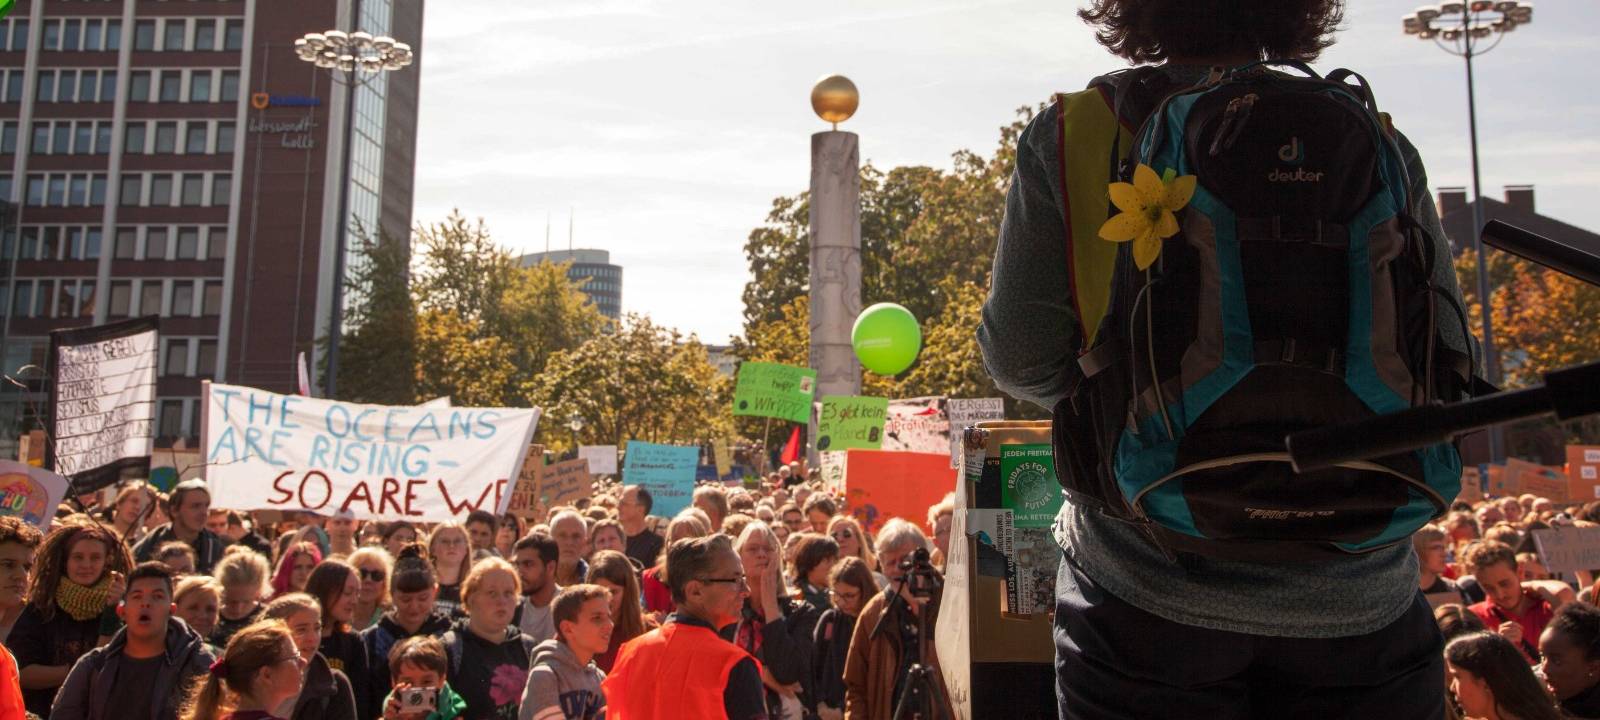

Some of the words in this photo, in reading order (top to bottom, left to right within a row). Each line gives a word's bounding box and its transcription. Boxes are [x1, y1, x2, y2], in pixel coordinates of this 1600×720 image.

[1268, 167, 1325, 182] deuter
[214, 389, 303, 428] THE
[325, 404, 501, 442] OCEANS
[951, 411, 965, 421] DAS
[868, 426, 880, 442] B
[209, 426, 292, 466] ARE
[309, 434, 430, 477] RISING
[1004, 450, 1026, 459] JEDEN
[1008, 461, 1031, 489] FRIDAYS
[1032, 461, 1048, 474] FOR
[267, 470, 333, 510] SO
[340, 477, 427, 516] ARE
[1024, 492, 1053, 510] FUTURE
